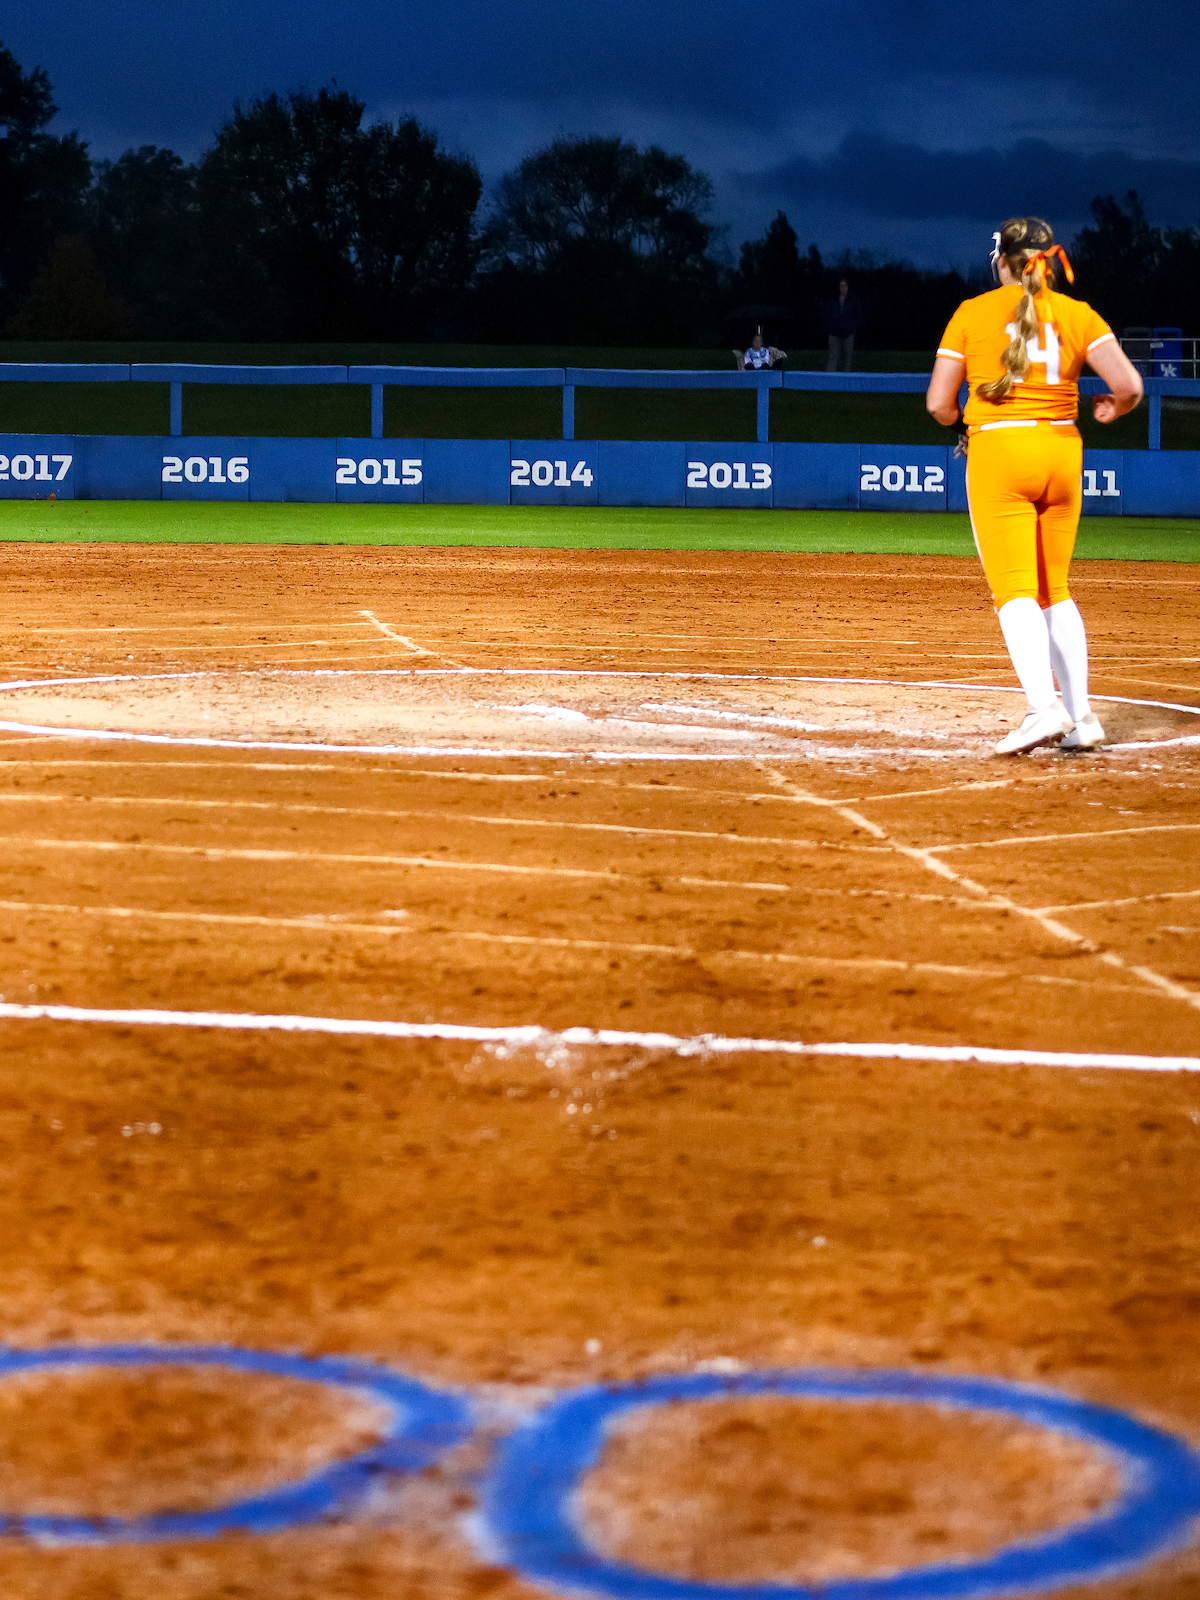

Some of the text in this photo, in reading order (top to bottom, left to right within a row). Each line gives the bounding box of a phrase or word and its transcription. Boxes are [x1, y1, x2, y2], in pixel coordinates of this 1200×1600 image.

[161, 456, 250, 483] 2016
[335, 457, 423, 485] 2015
[510, 460, 594, 487] 2014
[686, 461, 773, 489] 2013
[860, 464, 946, 493] 2012
[1084, 469, 1121, 497] 11
